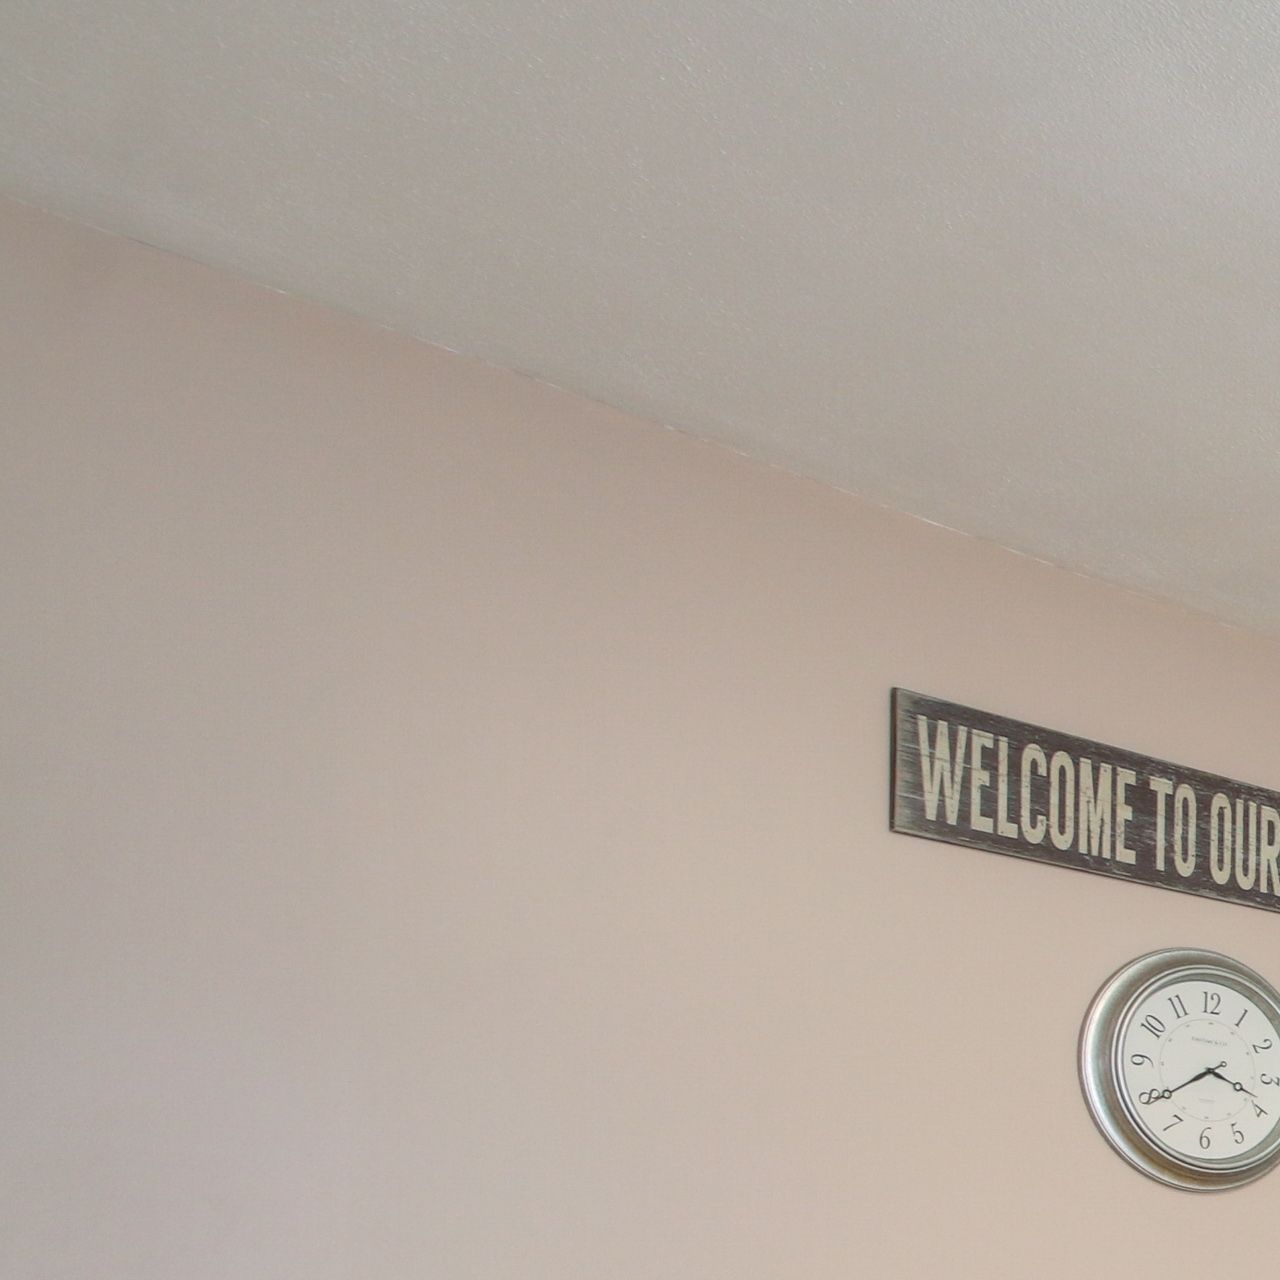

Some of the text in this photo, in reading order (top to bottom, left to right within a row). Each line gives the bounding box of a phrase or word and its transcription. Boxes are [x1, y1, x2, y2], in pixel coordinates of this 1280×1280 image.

[916, 713, 1137, 866] WELCOME
[1149, 775, 1197, 878] TO
[1167, 994, 1189, 1019] 11
[1202, 991, 1222, 1016] 12
[1140, 1014, 1167, 1039] 10
[1234, 1009, 1248, 1028] 1
[1252, 1038, 1273, 1054] 2
[1130, 1053, 1154, 1068] 9
[1260, 1073, 1280, 1087] 3
[1138, 1088, 1161, 1105] 8
[1251, 1100, 1269, 1118] 4
[1162, 1114, 1184, 1132] 7
[1199, 1127, 1212, 1150] 6
[1230, 1122, 1245, 1145] 5
